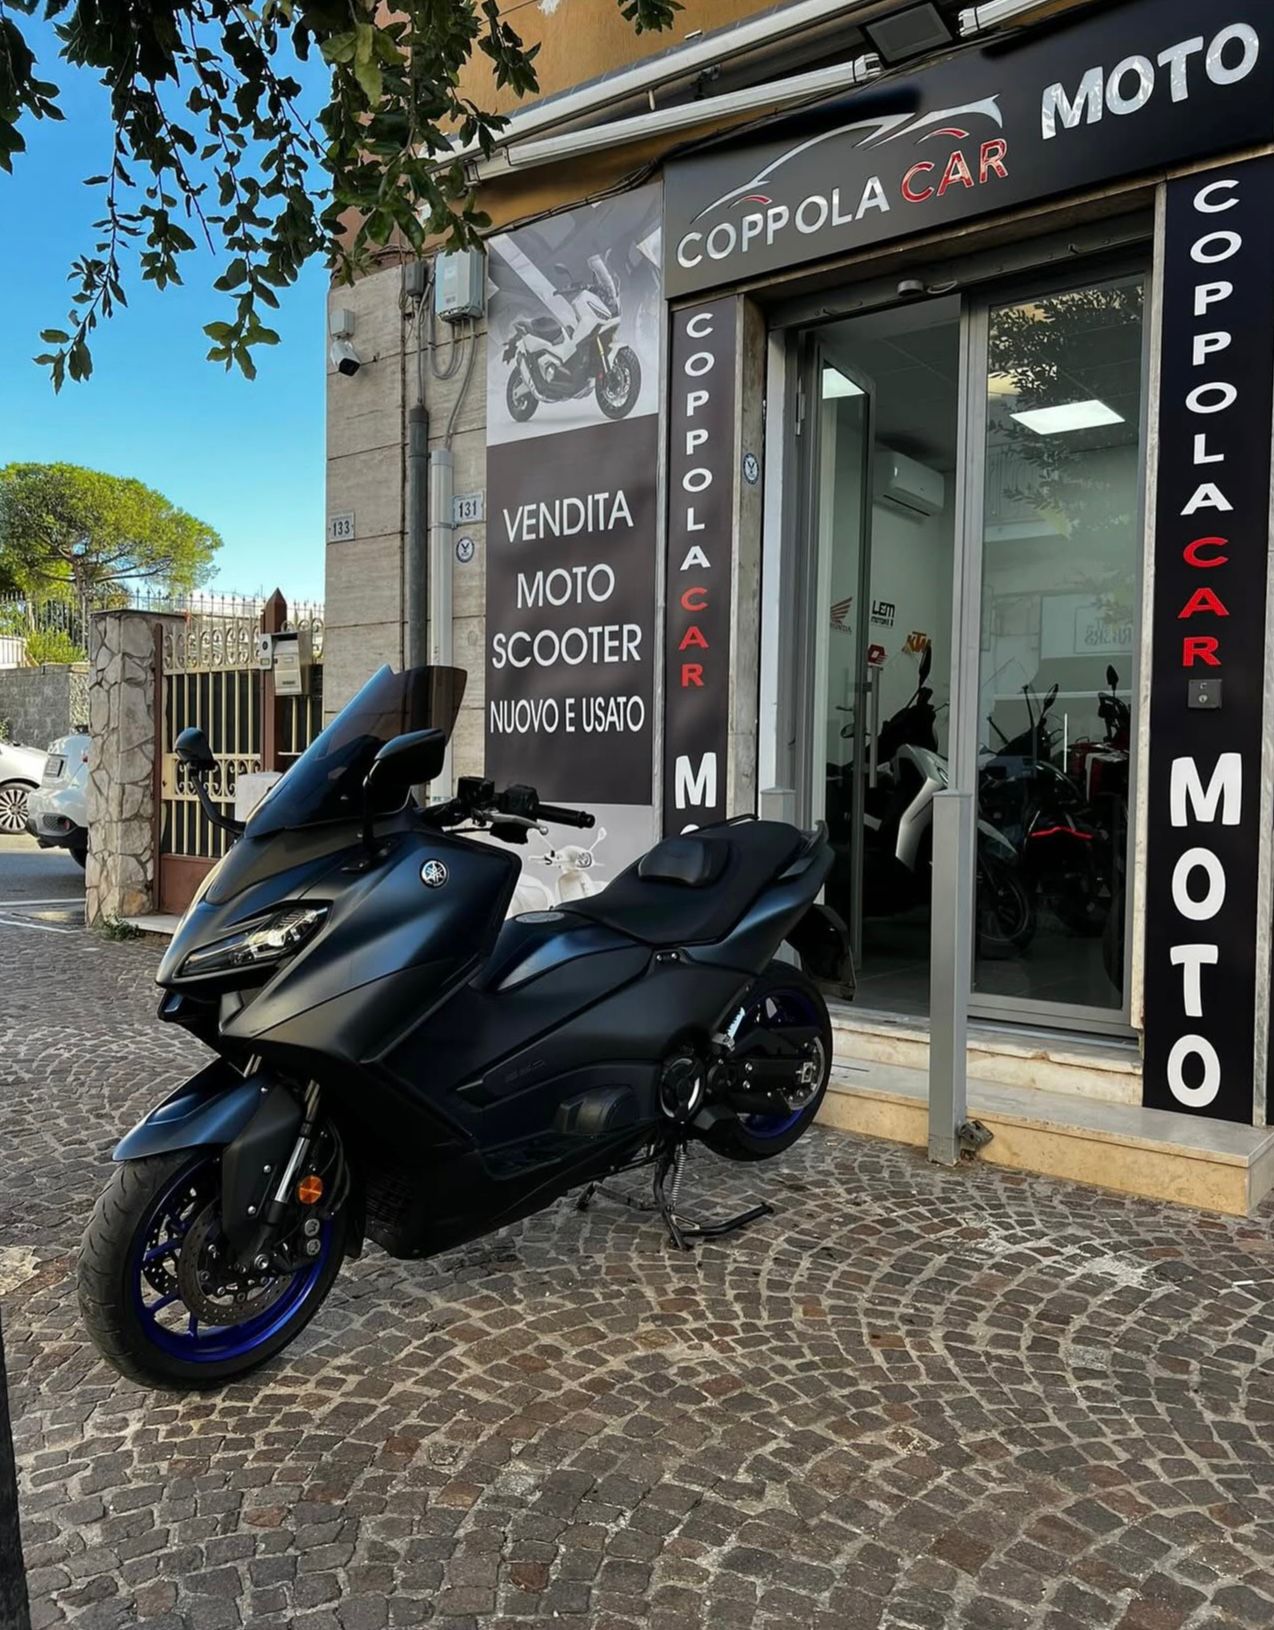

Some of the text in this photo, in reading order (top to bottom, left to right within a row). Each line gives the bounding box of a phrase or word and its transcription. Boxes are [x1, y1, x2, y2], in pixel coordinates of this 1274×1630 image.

[1041, 22, 1260, 140] MOTO
[676, 138, 1009, 268] COPPOLA CAR
[332, 520, 351, 537] 133
[458, 500, 477, 518] 131
[502, 489, 634, 543] VENDITA
[516, 563, 616, 609] MOTO
[492, 623, 642, 669] SCOOTER
[490, 695, 645, 734] NUOVO E USATO
[1167, 752, 1242, 1108] MOTO
